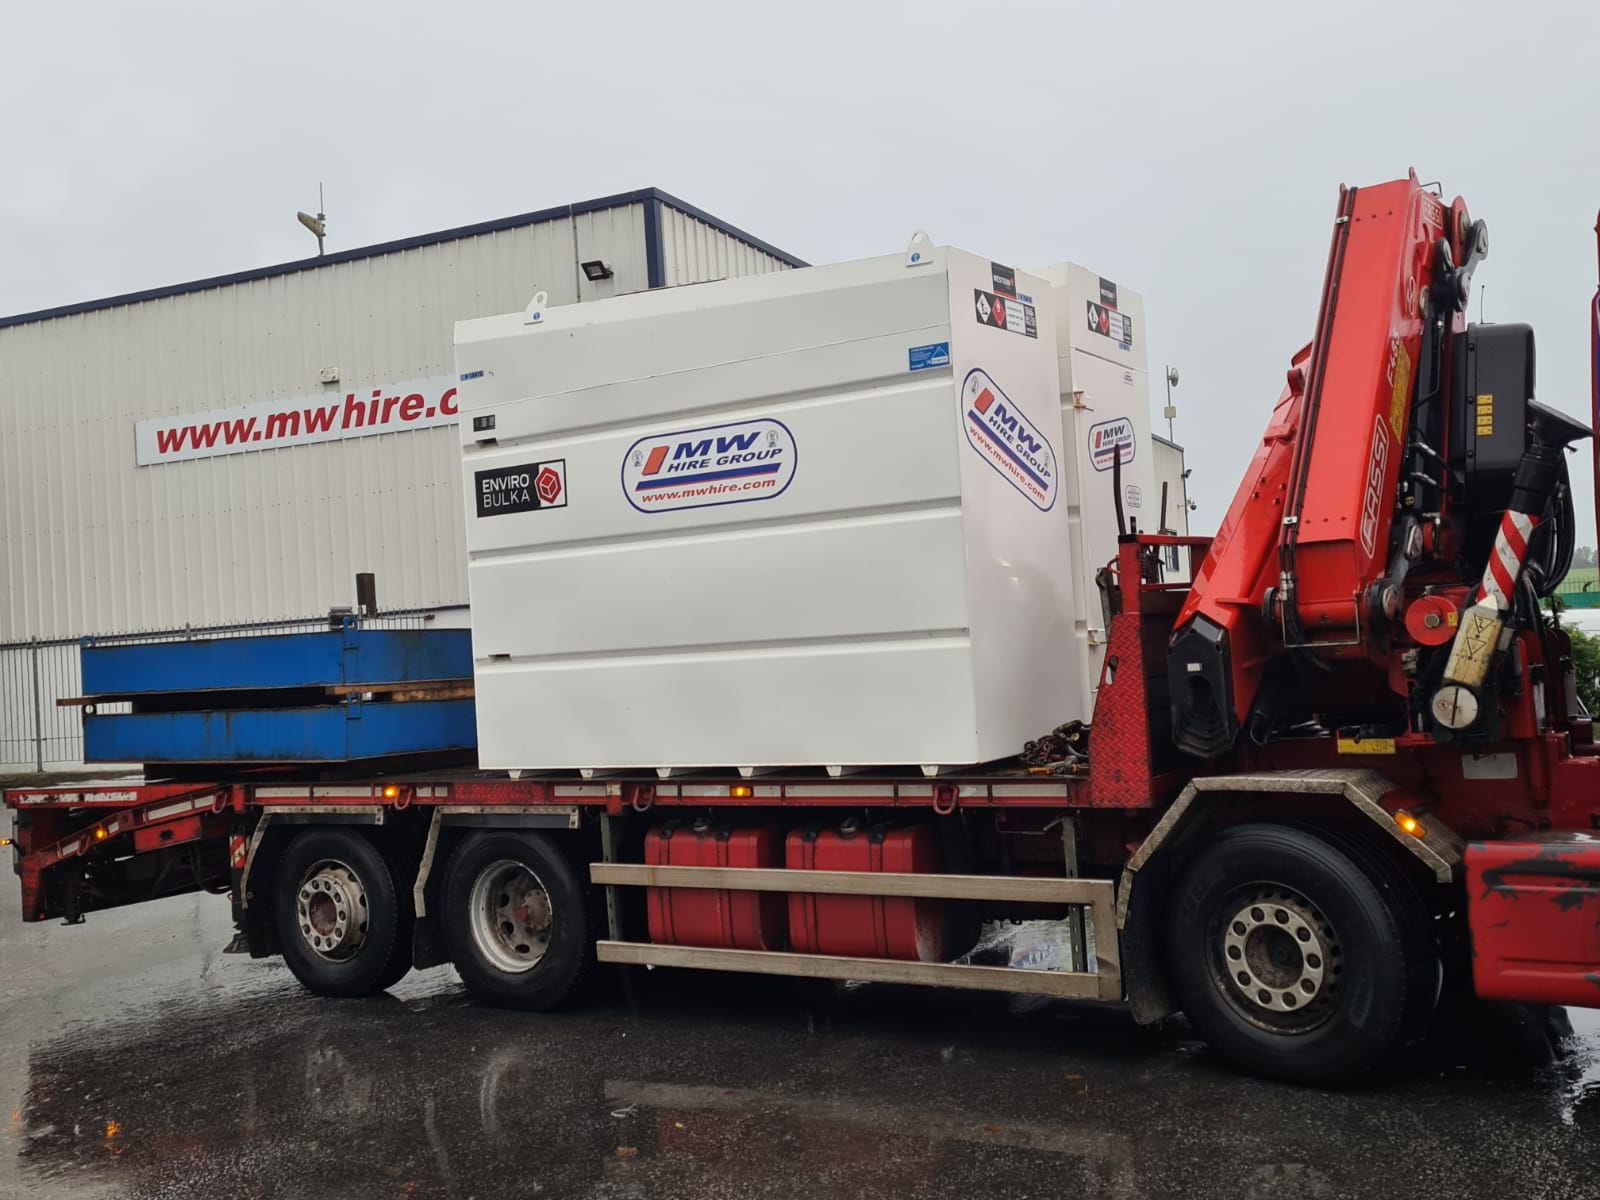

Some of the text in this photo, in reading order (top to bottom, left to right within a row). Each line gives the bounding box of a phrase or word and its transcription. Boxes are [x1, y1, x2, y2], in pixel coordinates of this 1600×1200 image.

[994, 403, 1043, 454] MW
[1103, 425, 1125, 440] MW
[673, 431, 761, 461] MW
[988, 416, 1014, 445] HIRE
[1015, 443, 1051, 478] GROUP
[667, 448, 783, 473] HIRE GROUP
[970, 425, 1046, 502] www.mwhire.com
[482, 473, 530, 493] ENVIRO
[642, 479, 776, 503] www.mwhire.com
[1362, 425, 1387, 548] FASSI
[484, 489, 530, 508] BULKA
